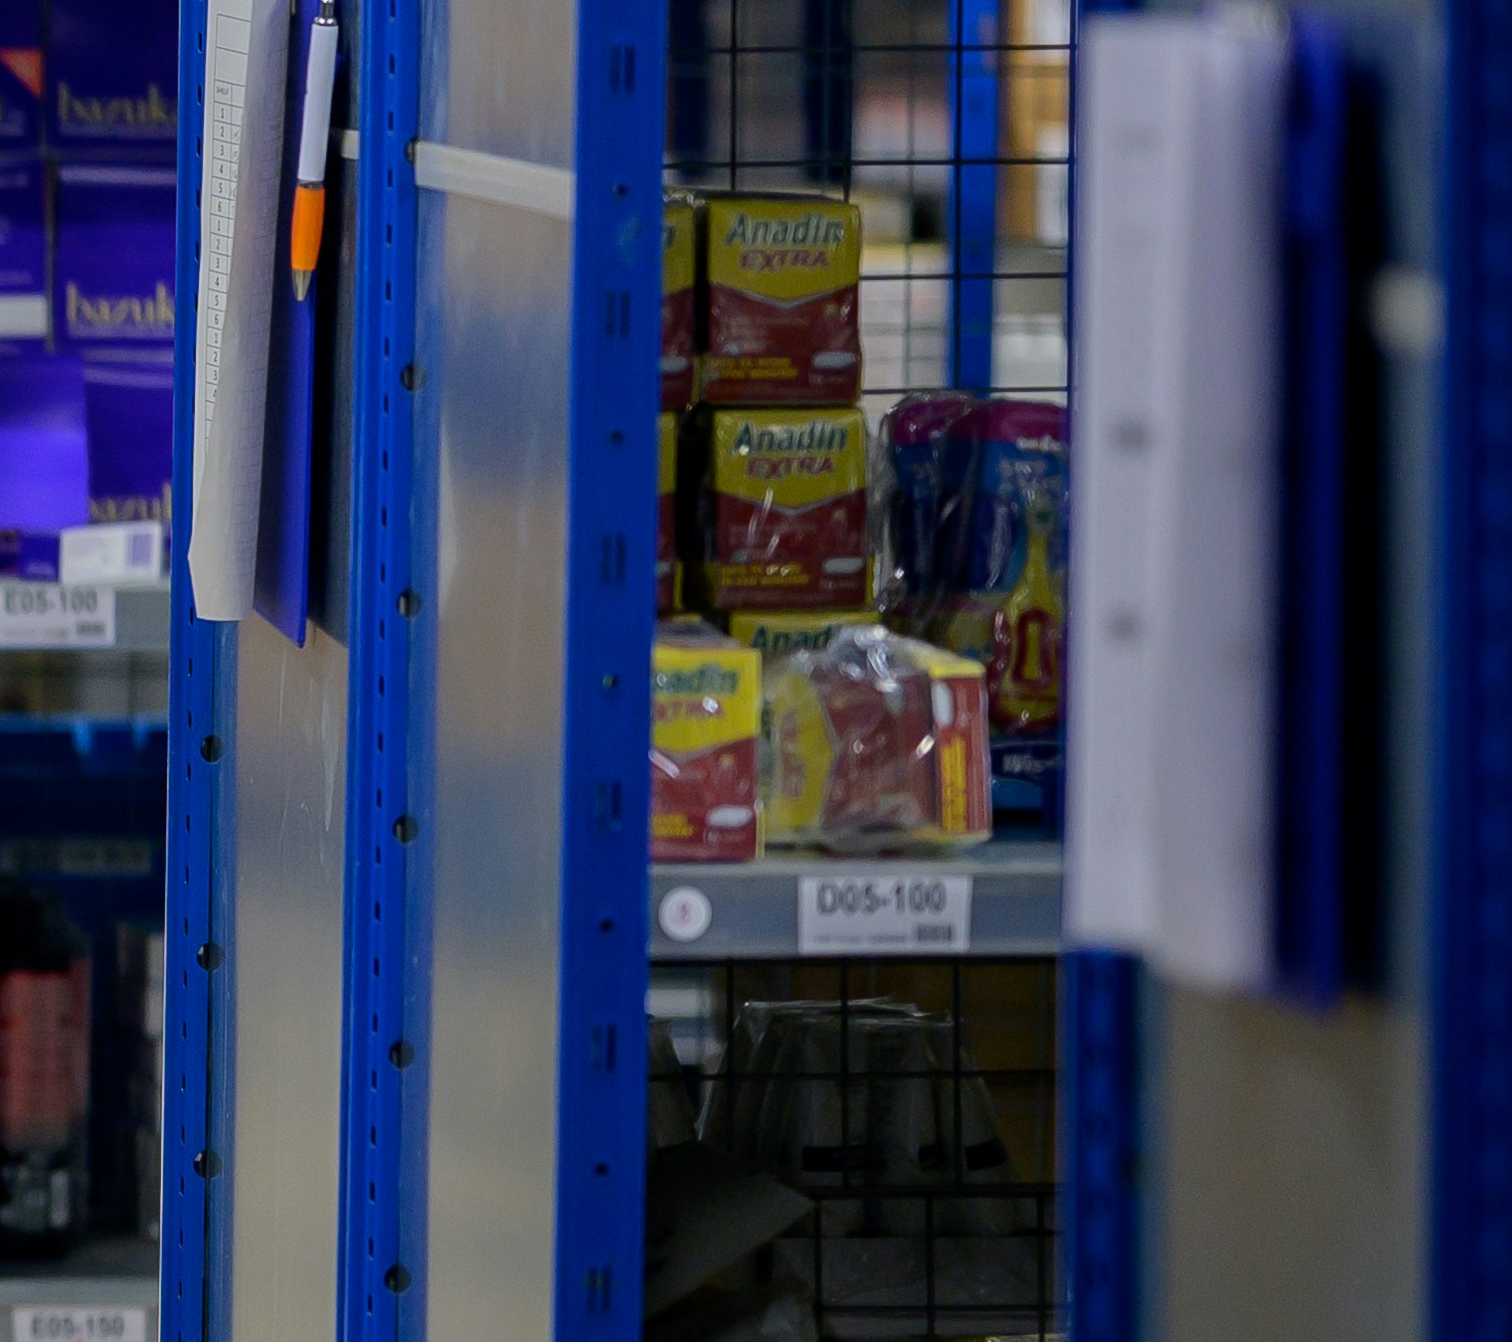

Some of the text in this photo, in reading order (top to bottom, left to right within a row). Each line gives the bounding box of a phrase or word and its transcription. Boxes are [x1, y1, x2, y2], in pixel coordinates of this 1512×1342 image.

[726, 212, 846, 247] Anadin
[739, 249, 830, 273] EXTRA
[731, 421, 848, 456] Anadin
[746, 456, 835, 480] EXTRA
[818, 880, 947, 913] D05-100
